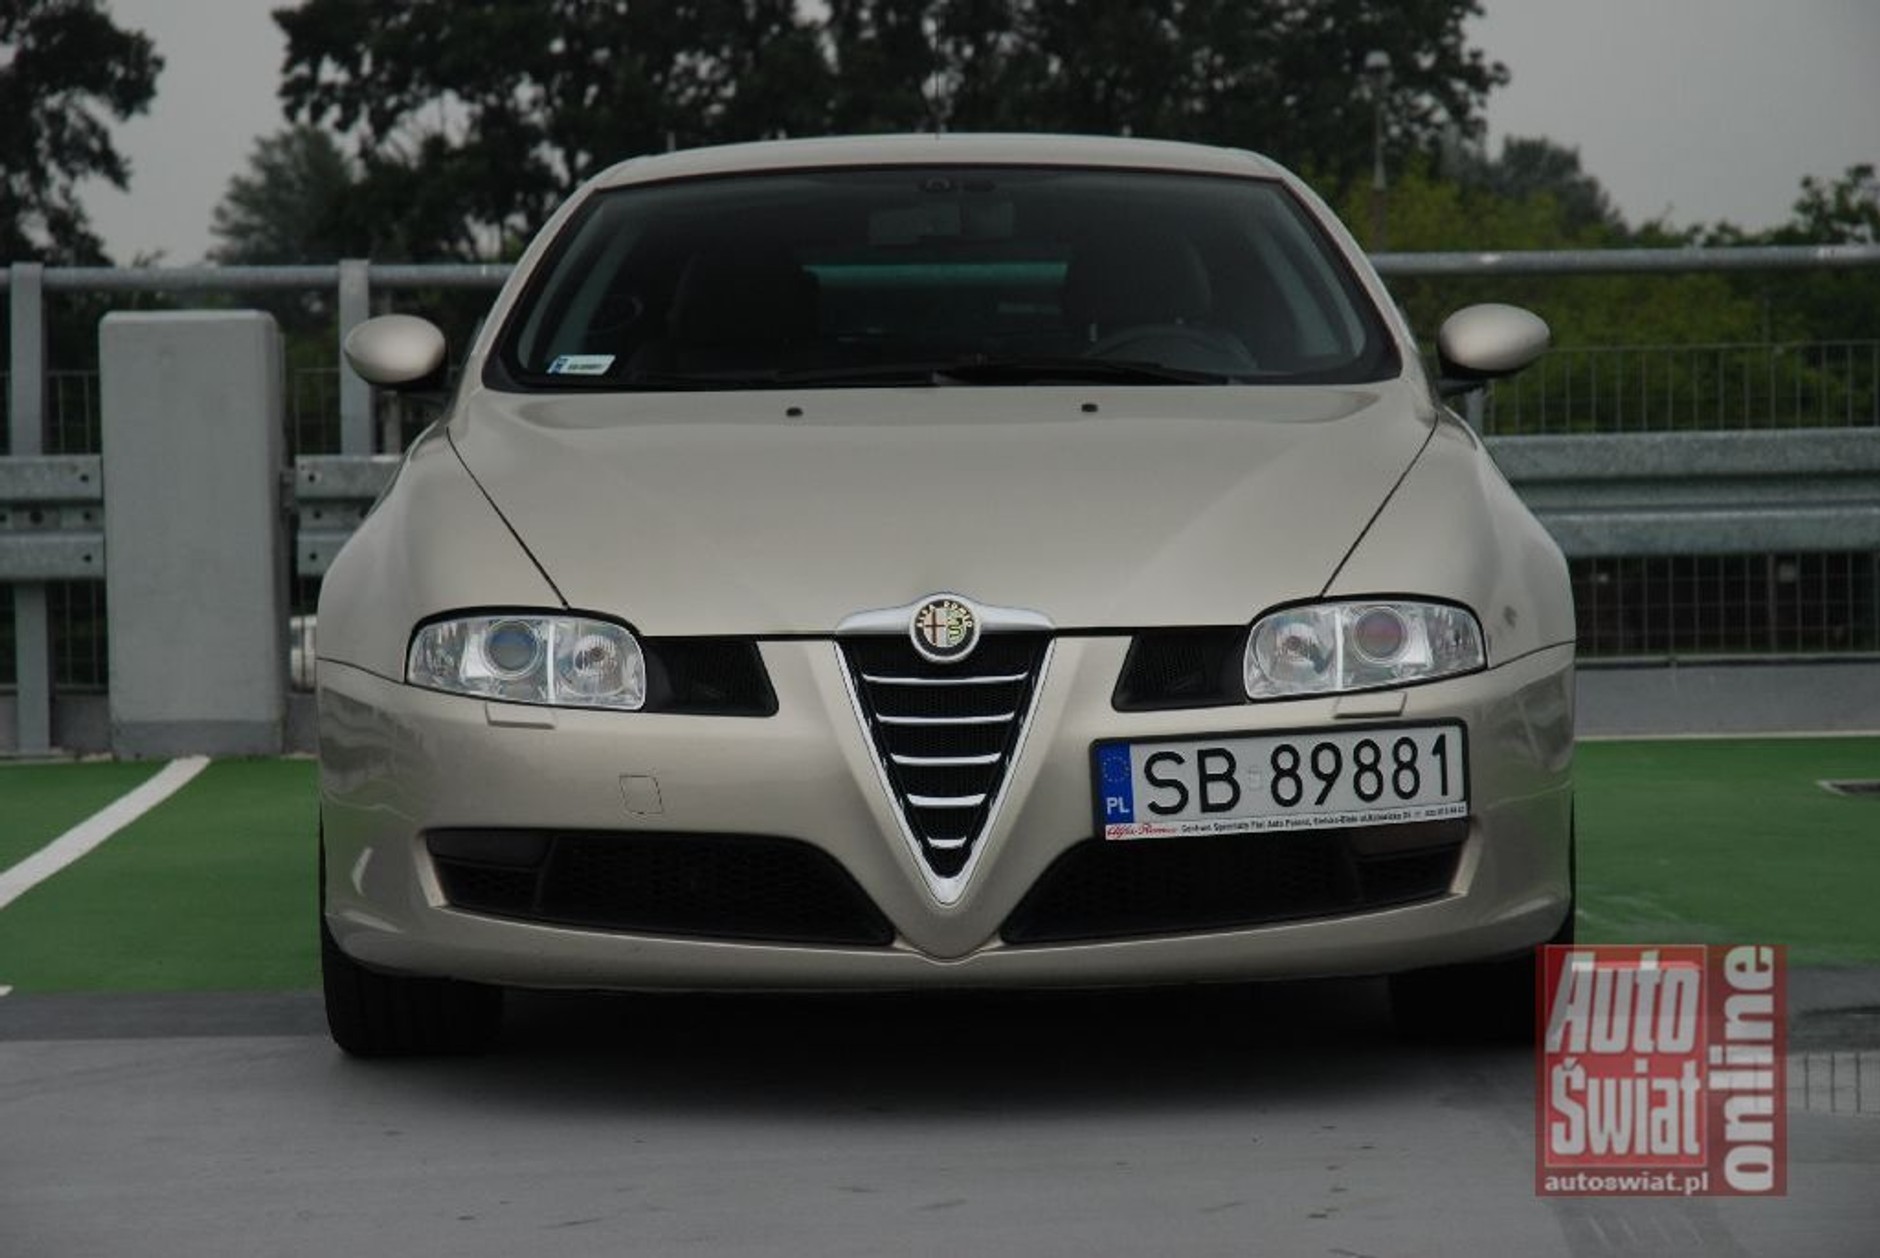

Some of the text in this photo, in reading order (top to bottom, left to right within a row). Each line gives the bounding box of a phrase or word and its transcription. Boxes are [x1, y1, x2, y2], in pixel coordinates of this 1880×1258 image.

[1144, 733, 1448, 815] SB 89881
[1106, 797, 1130, 815] PL
